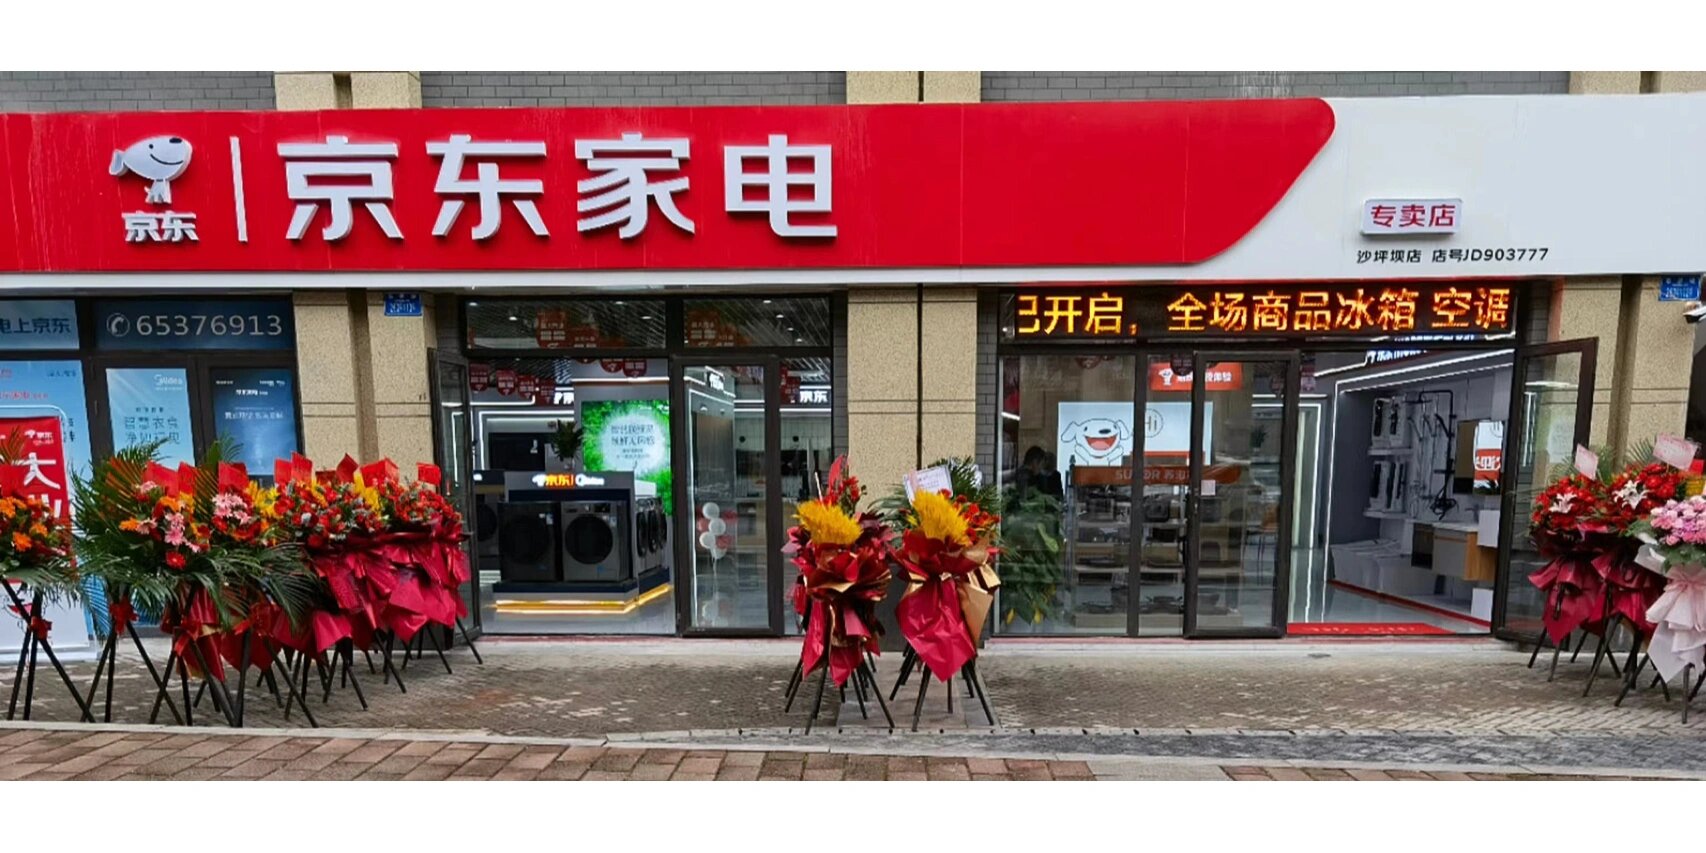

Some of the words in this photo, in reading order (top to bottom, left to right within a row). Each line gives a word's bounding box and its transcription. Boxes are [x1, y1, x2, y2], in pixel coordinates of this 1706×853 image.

[277, 132, 838, 240] 京东家电
[121, 210, 199, 242] 京东
[1370, 204, 1456, 228] 专卖店
[1356, 249, 1421, 264] 沙坪坝店
[1432, 248, 1549, 263] 店号JD903777
[1432, 287, 1510, 329] 空调
[136, 315, 282, 336] 65376913
[1114, 469, 1160, 481] SUOR
